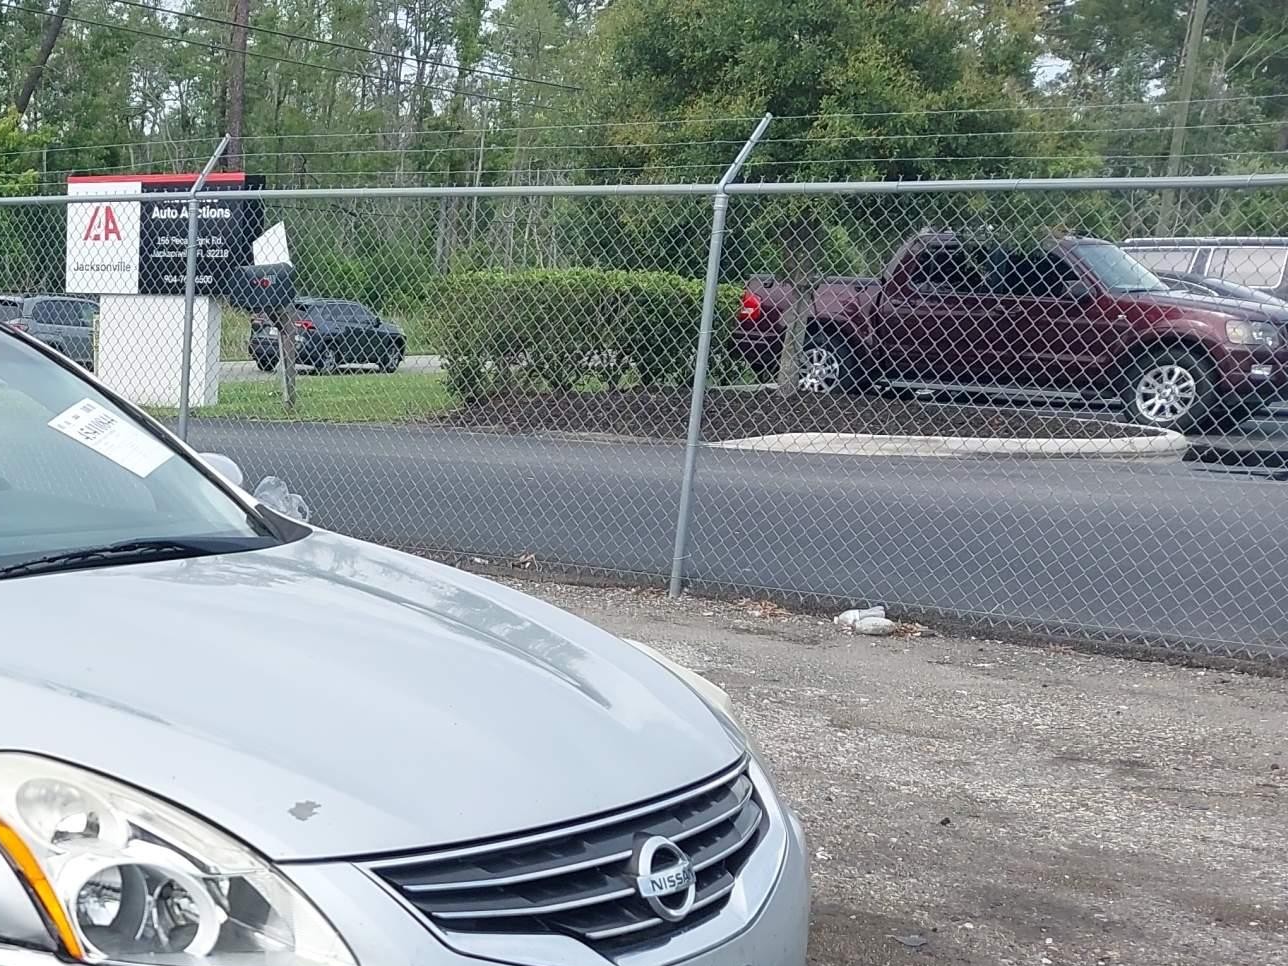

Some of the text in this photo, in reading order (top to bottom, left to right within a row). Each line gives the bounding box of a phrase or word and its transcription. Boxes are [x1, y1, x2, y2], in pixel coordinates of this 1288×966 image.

[152, 205, 231, 219] Auto Ations
[171, 236, 188, 245] Peca
[151, 248, 188, 258] Jacksonvil
[206, 249, 229, 258] 32218
[73, 261, 131, 272] Jacksonville
[164, 274, 213, 284] 904-76500
